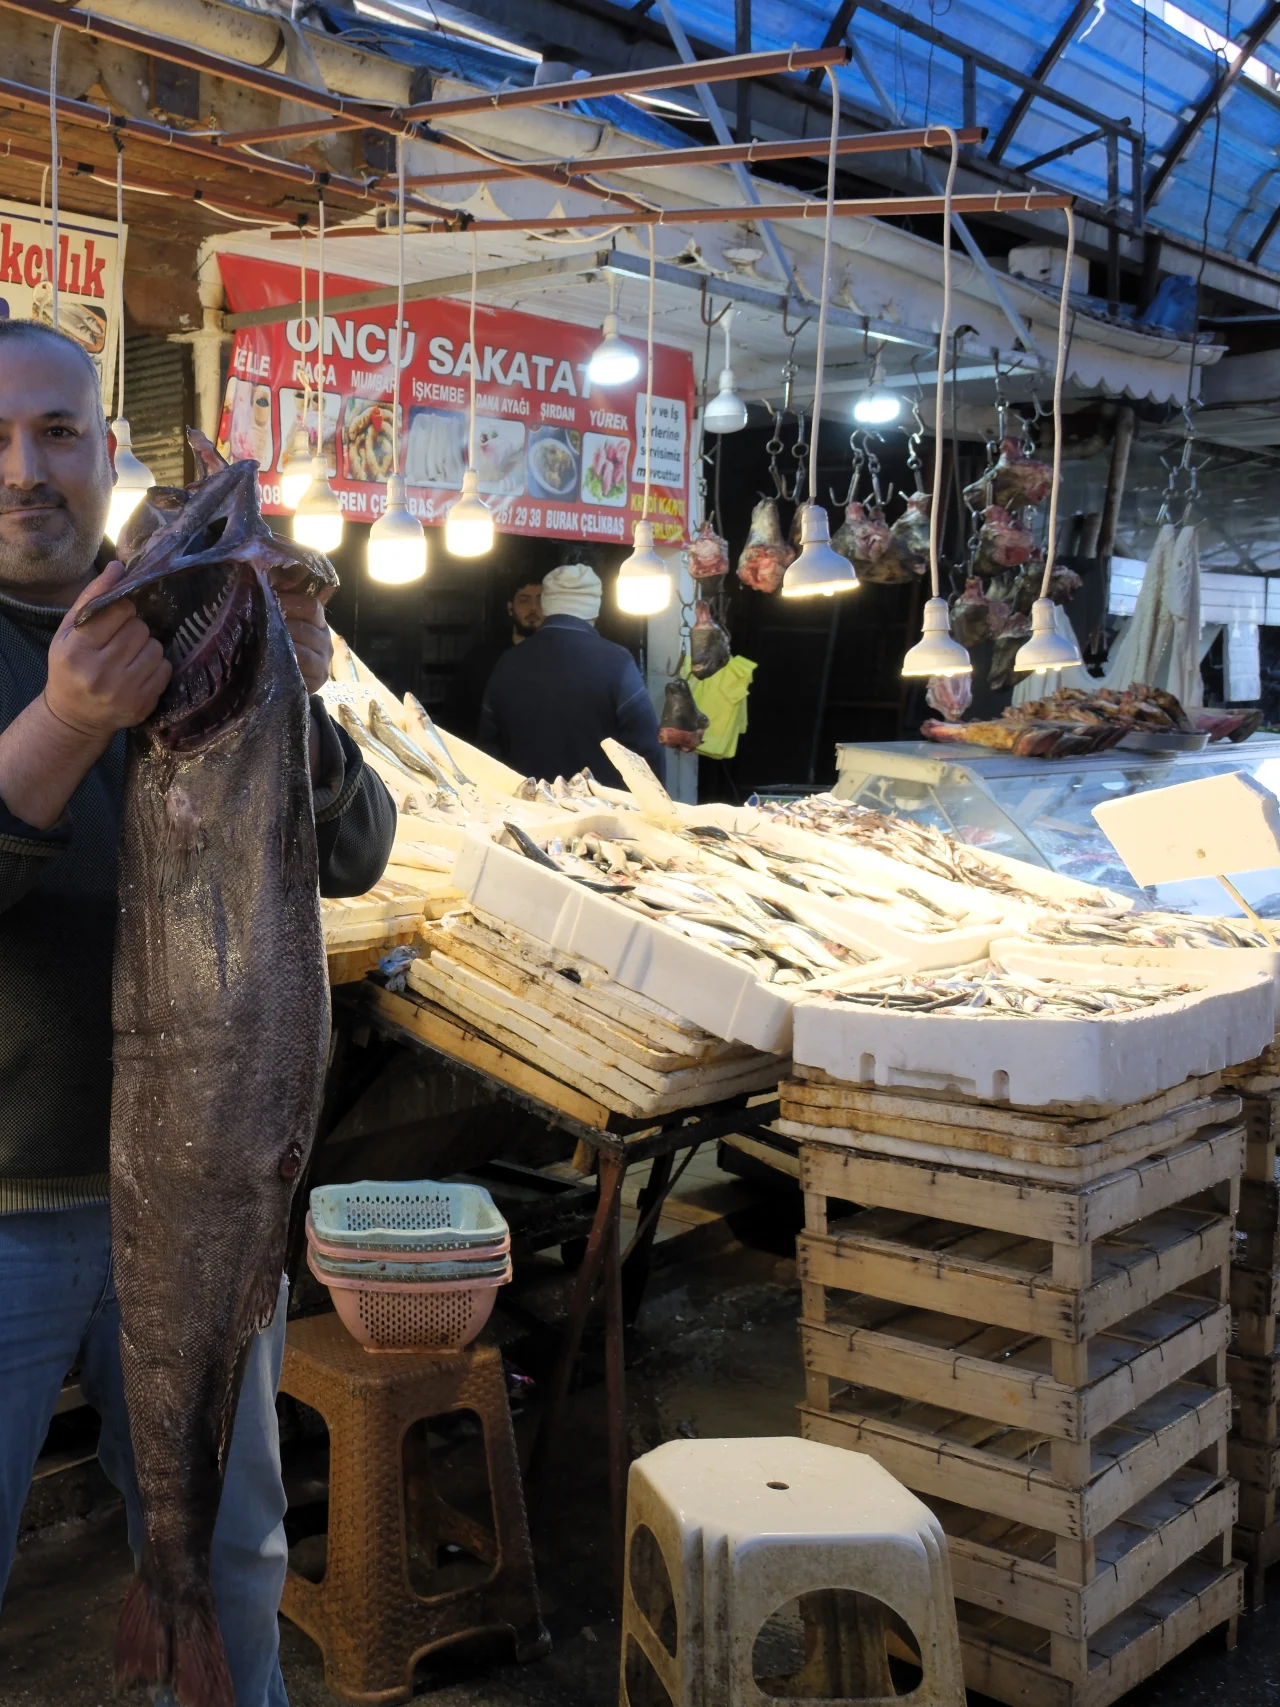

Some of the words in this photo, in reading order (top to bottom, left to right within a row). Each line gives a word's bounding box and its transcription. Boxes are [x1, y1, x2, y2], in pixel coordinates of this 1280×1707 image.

[412, 377, 465, 404] İŞKEMBE
[476, 393, 499, 411] DANA
[501, 397, 530, 416] AYAĞI
[540, 402, 575, 421] ŞIRDAN
[589, 410, 628, 431] YÜREK
[641, 424, 680, 442] yrlerine
[640, 446, 681, 462] srvisimiz
[637, 467, 681, 482] mvcuttur
[515, 506, 527, 526] 29
[528, 508, 541, 528] 38
[546, 508, 579, 531] BURAK
[580, 511, 625, 540] ÇELİKBAŞ
